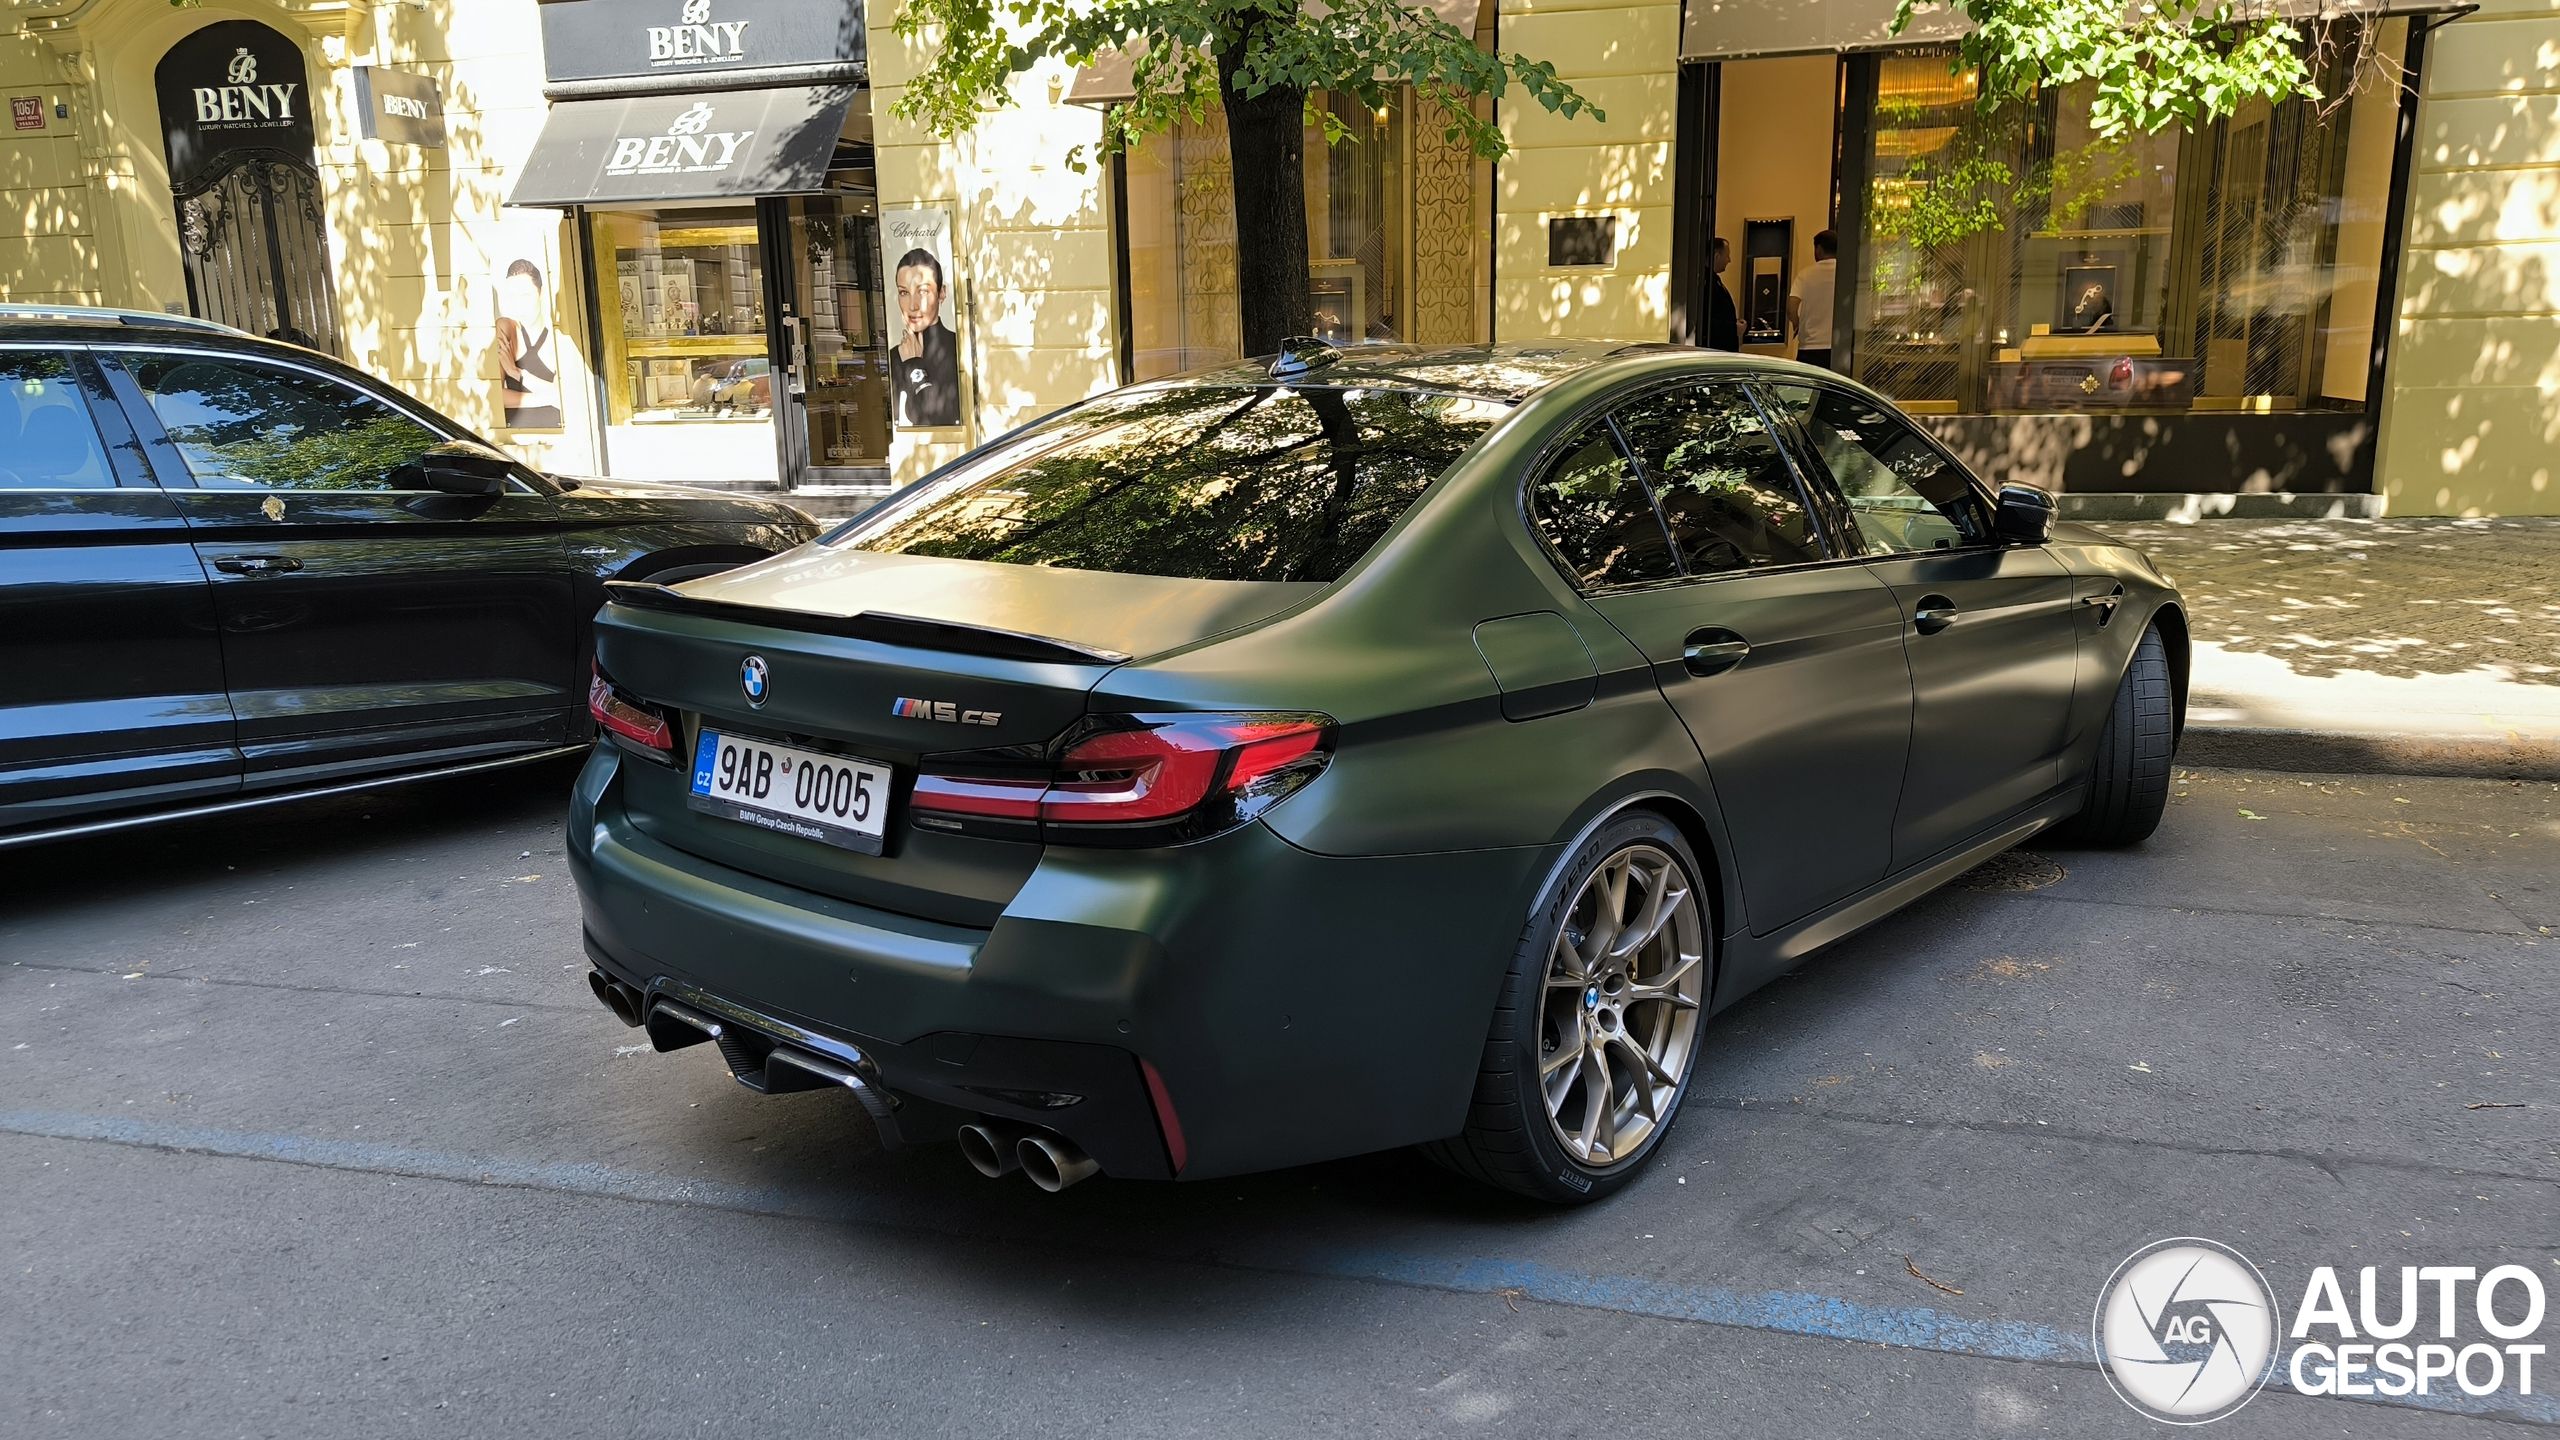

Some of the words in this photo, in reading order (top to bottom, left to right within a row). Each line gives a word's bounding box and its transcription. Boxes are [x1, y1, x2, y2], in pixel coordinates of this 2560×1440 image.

[647, 21, 749, 60] BENY
[13, 100, 36, 116] 1067
[192, 83, 299, 122] BENY
[382, 93, 429, 120] BENY
[260, 120, 295, 128] JEWELLERY
[605, 131, 754, 170] BENY
[890, 220, 942, 240] Chopard
[742, 658, 765, 675] BMW
[909, 698, 957, 722] M5
[961, 710, 1002, 726] CS
[696, 770, 711, 787] CZ
[719, 744, 774, 800] 9AB
[795, 760, 874, 822] 0005
[739, 809, 756, 822] BMW
[756, 814, 776, 828] Group
[776, 818, 796, 832] Czech
[796, 823, 824, 839] Republic
[1558, 1168, 1593, 1193] PIRELLI
